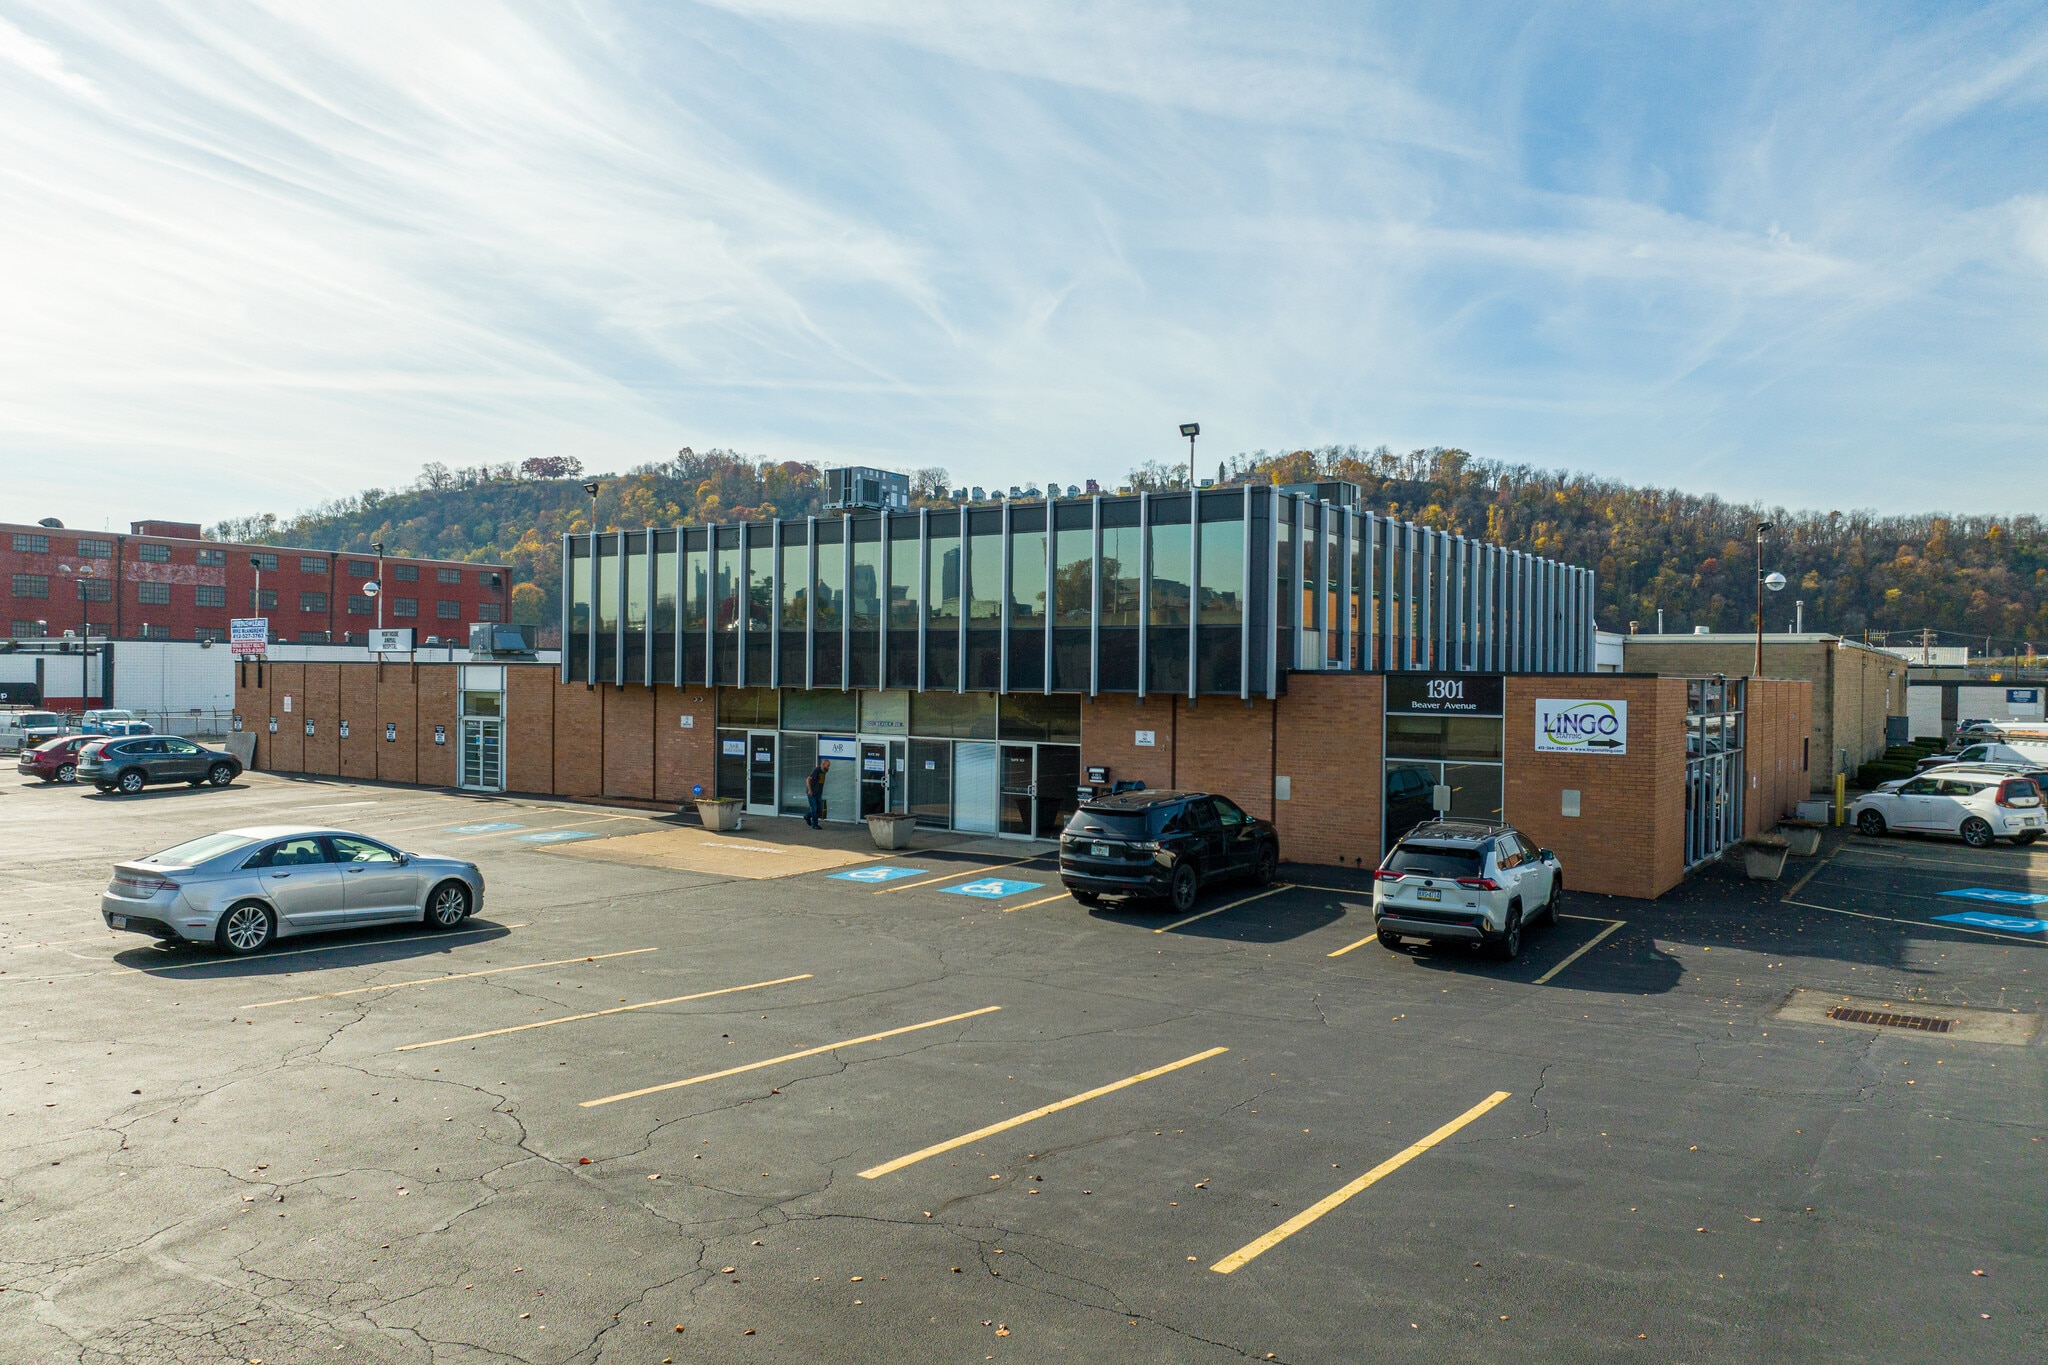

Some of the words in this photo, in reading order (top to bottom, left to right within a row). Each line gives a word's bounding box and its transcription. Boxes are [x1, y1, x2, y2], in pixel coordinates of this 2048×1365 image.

[1426, 680, 1464, 699] 1301
[1411, 701, 1440, 709] Beaver
[1444, 702, 1477, 710] Avenue
